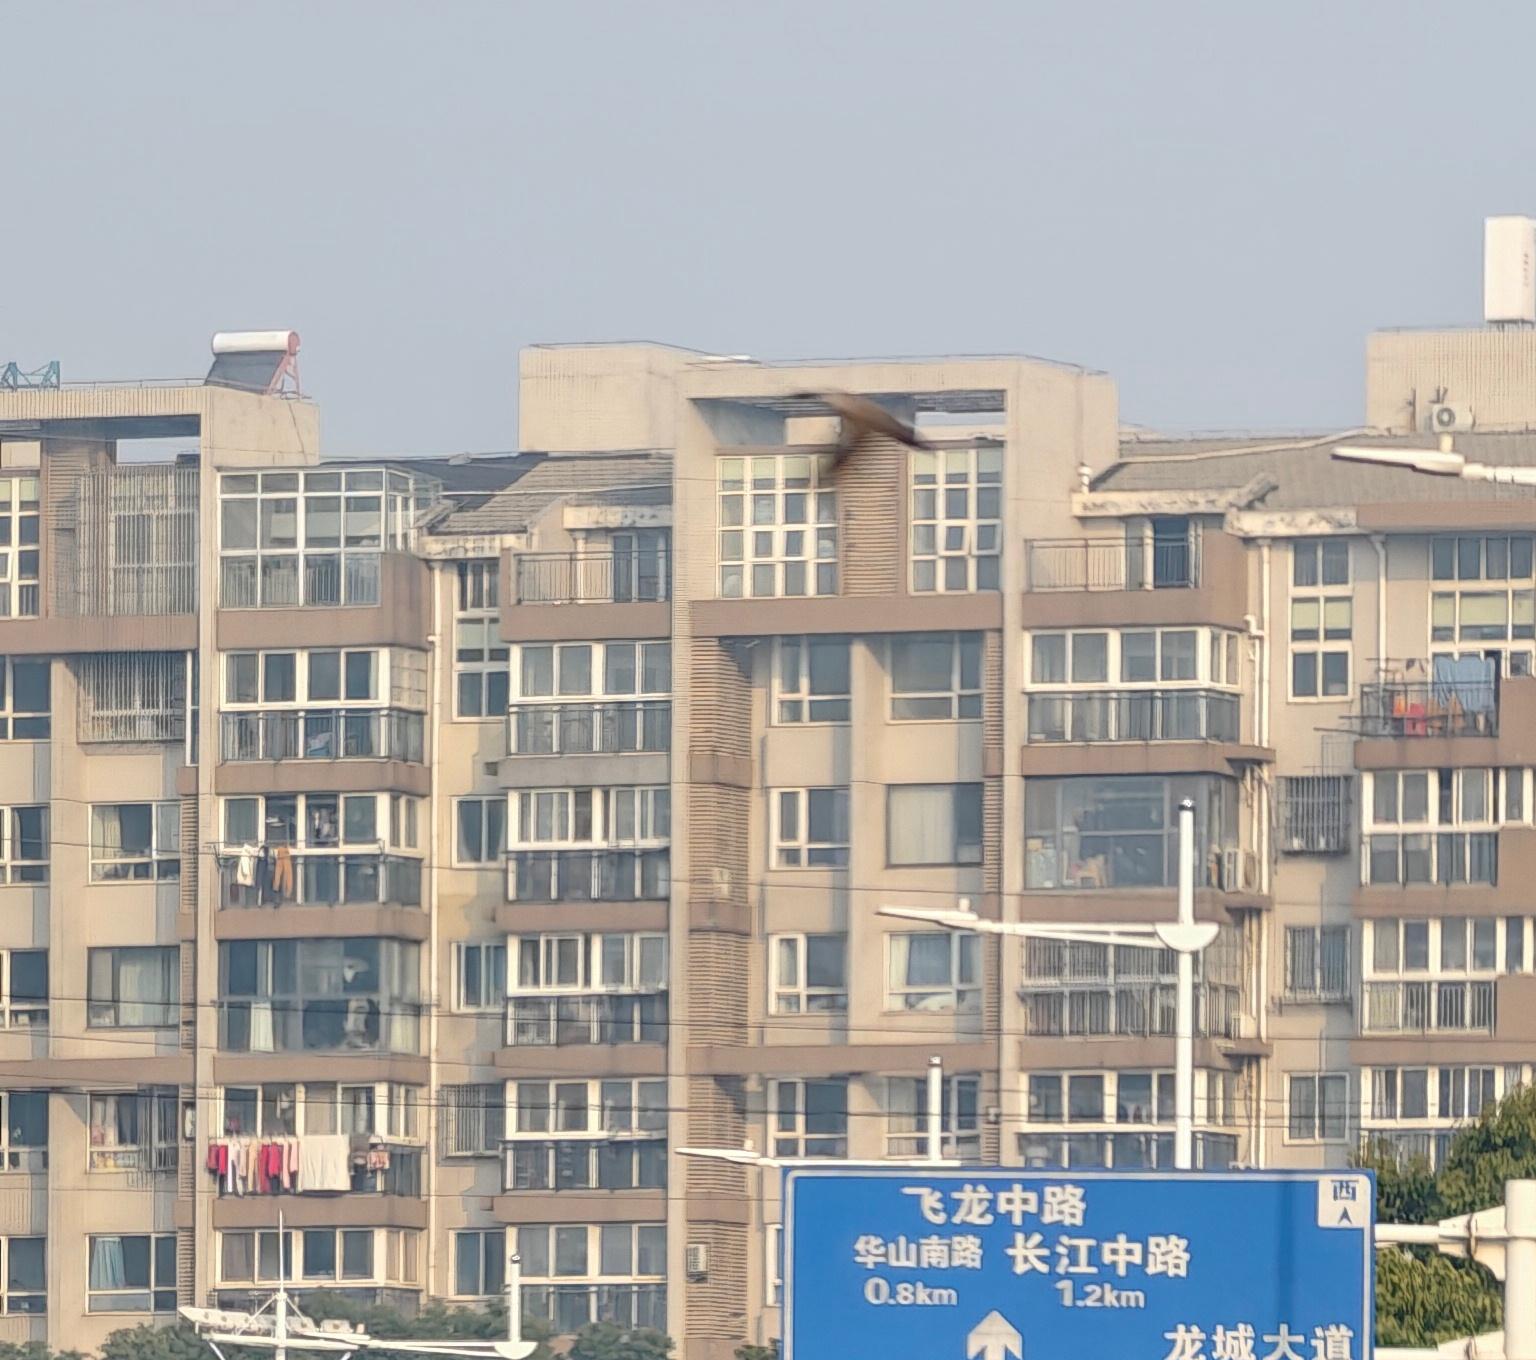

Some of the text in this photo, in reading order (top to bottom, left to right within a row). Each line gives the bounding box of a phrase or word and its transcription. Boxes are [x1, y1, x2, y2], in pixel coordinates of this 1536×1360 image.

[900, 1183, 1087, 1227] 飞龙中路
[854, 1234, 984, 1270] 华山南路
[1004, 1231, 1191, 1278] 长江中路
[864, 1276, 959, 1306] 0.8km
[1054, 1278, 1146, 1308] 1.2km
